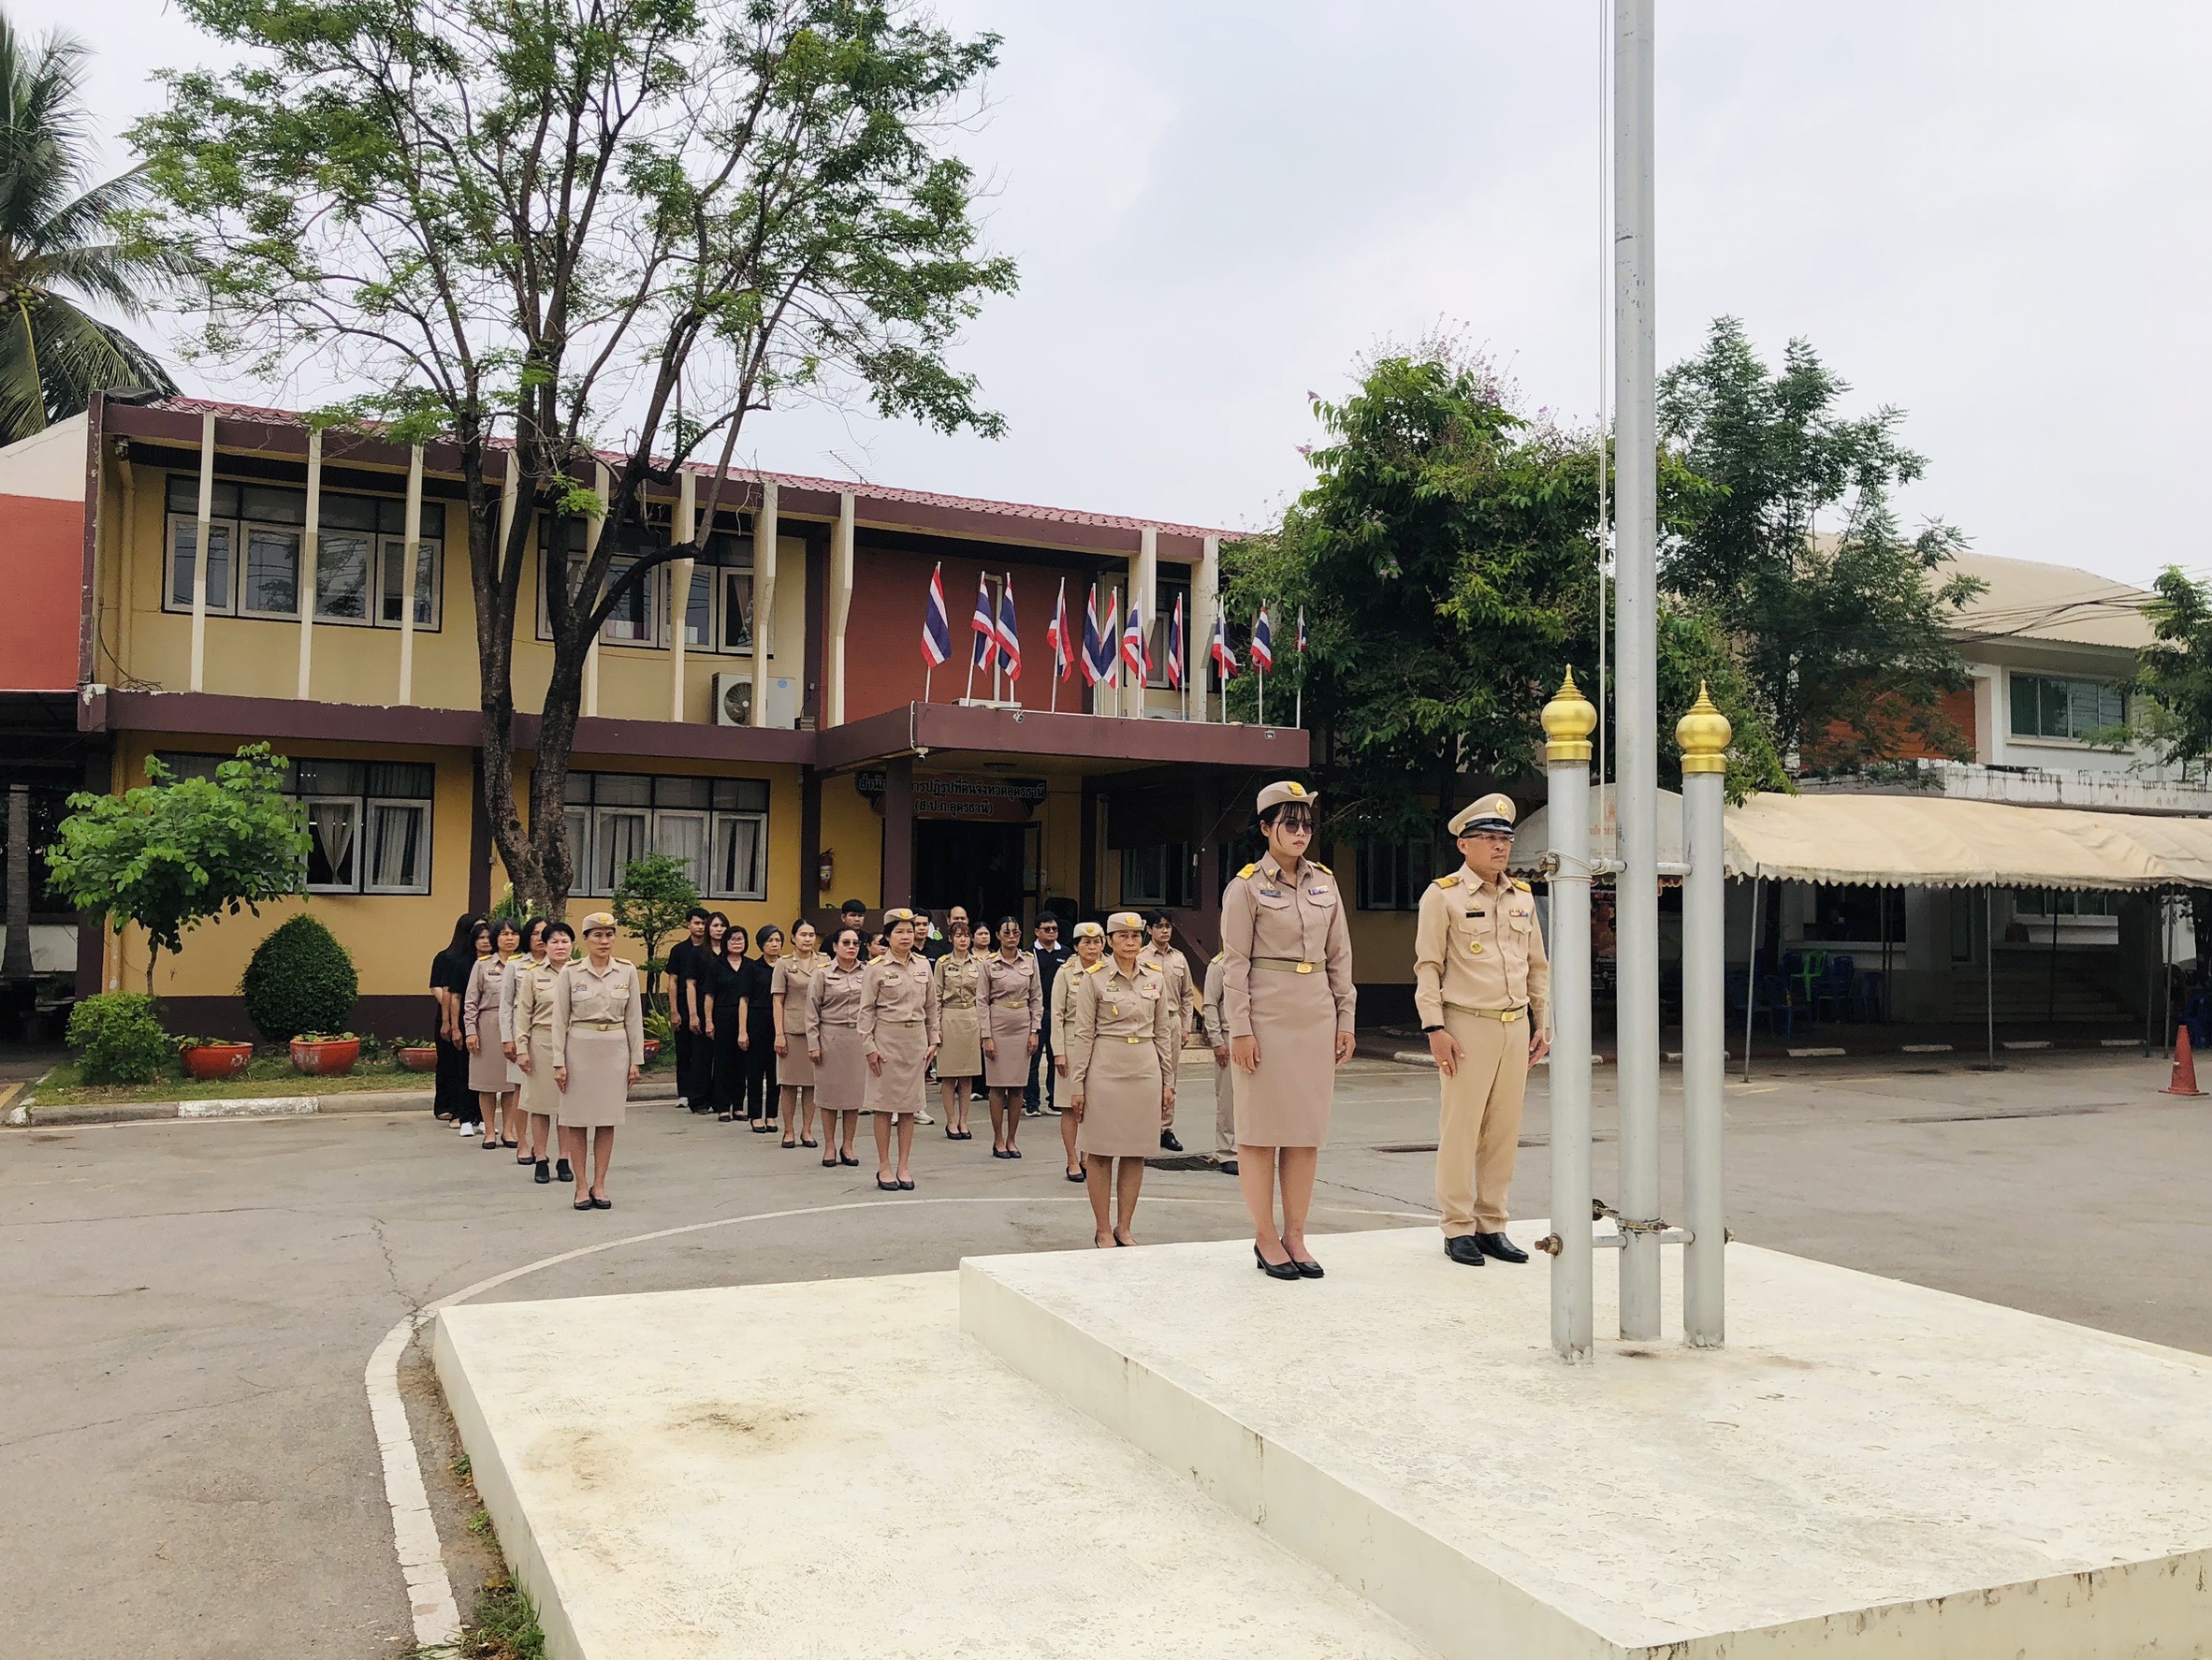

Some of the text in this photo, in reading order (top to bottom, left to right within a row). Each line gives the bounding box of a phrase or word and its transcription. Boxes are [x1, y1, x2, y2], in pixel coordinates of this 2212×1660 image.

[914, 798, 994, 818] (ส.ป.ก.อุดรธานี)
